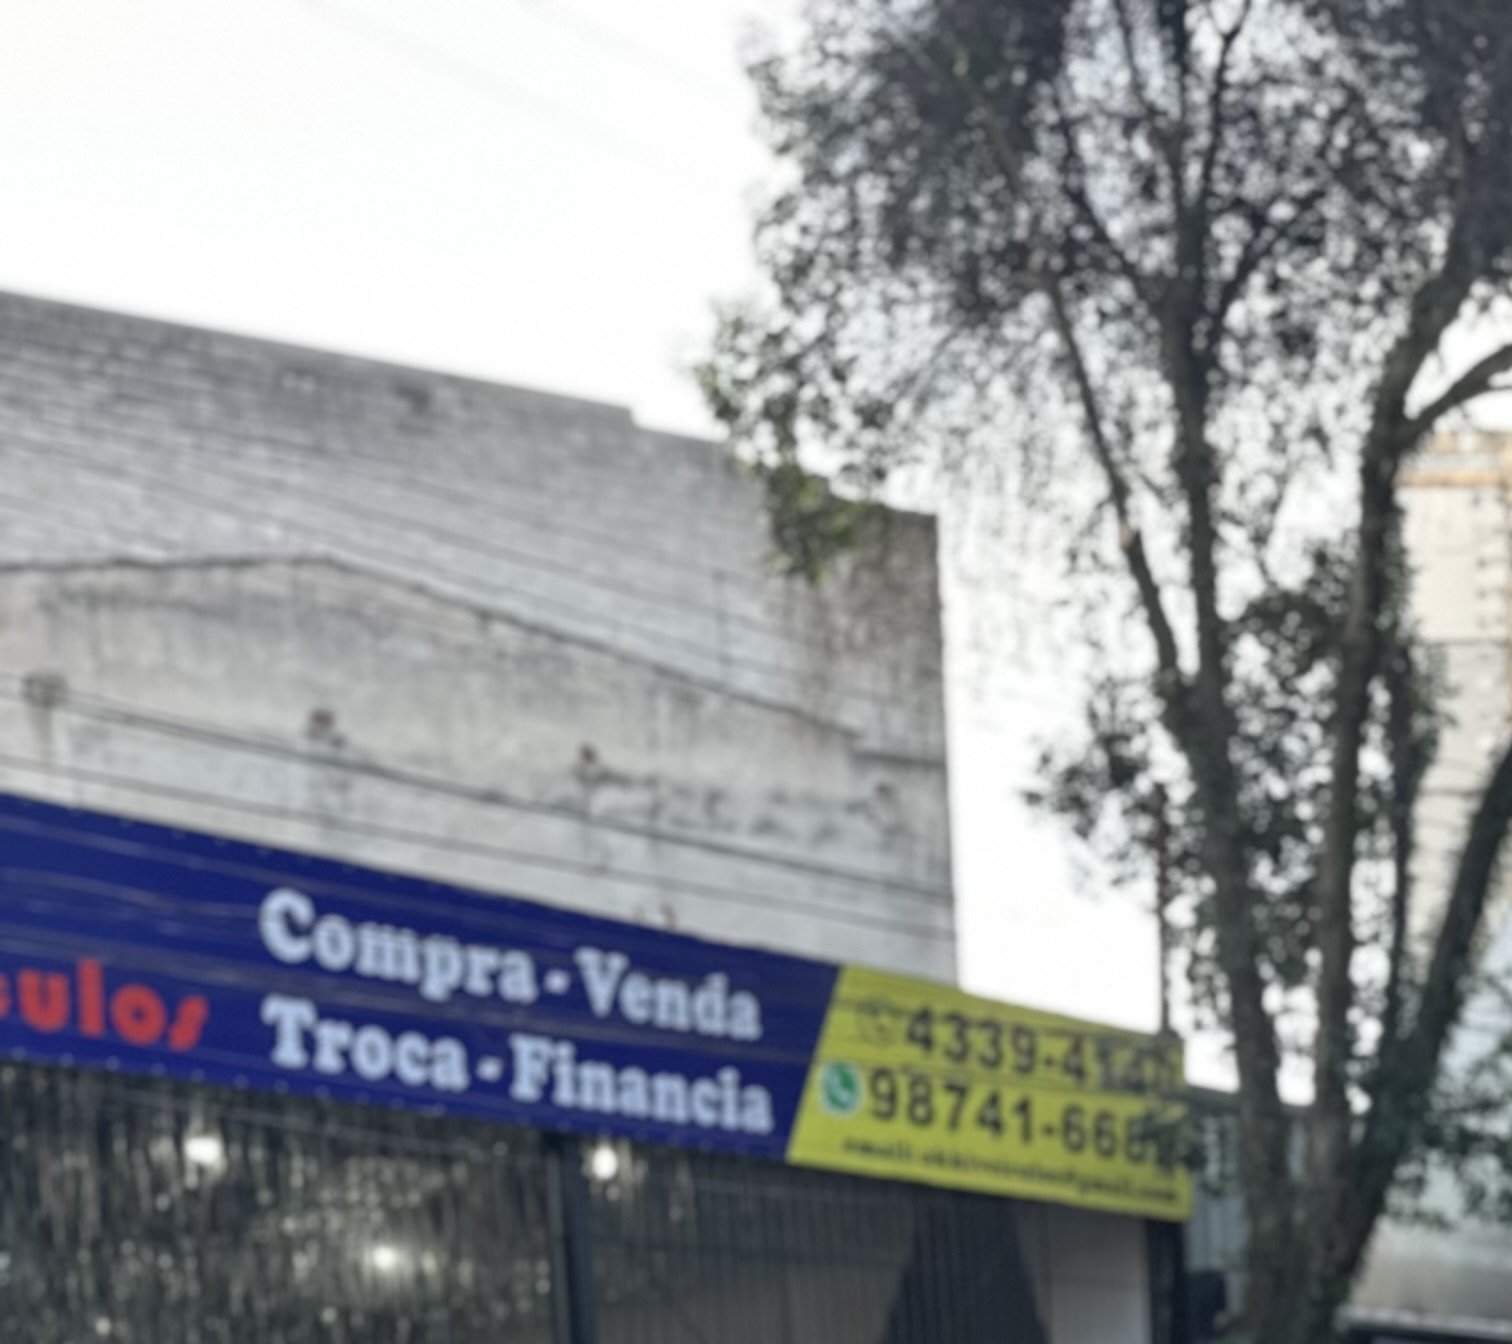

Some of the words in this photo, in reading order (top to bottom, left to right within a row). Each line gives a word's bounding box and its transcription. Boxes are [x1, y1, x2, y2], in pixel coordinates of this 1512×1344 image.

[0, 957, 208, 1050] ulos
[260, 889, 537, 1003] Compra
[575, 946, 762, 1041] Venda
[261, 994, 468, 1092] Troca
[510, 1033, 773, 1134] Financia
